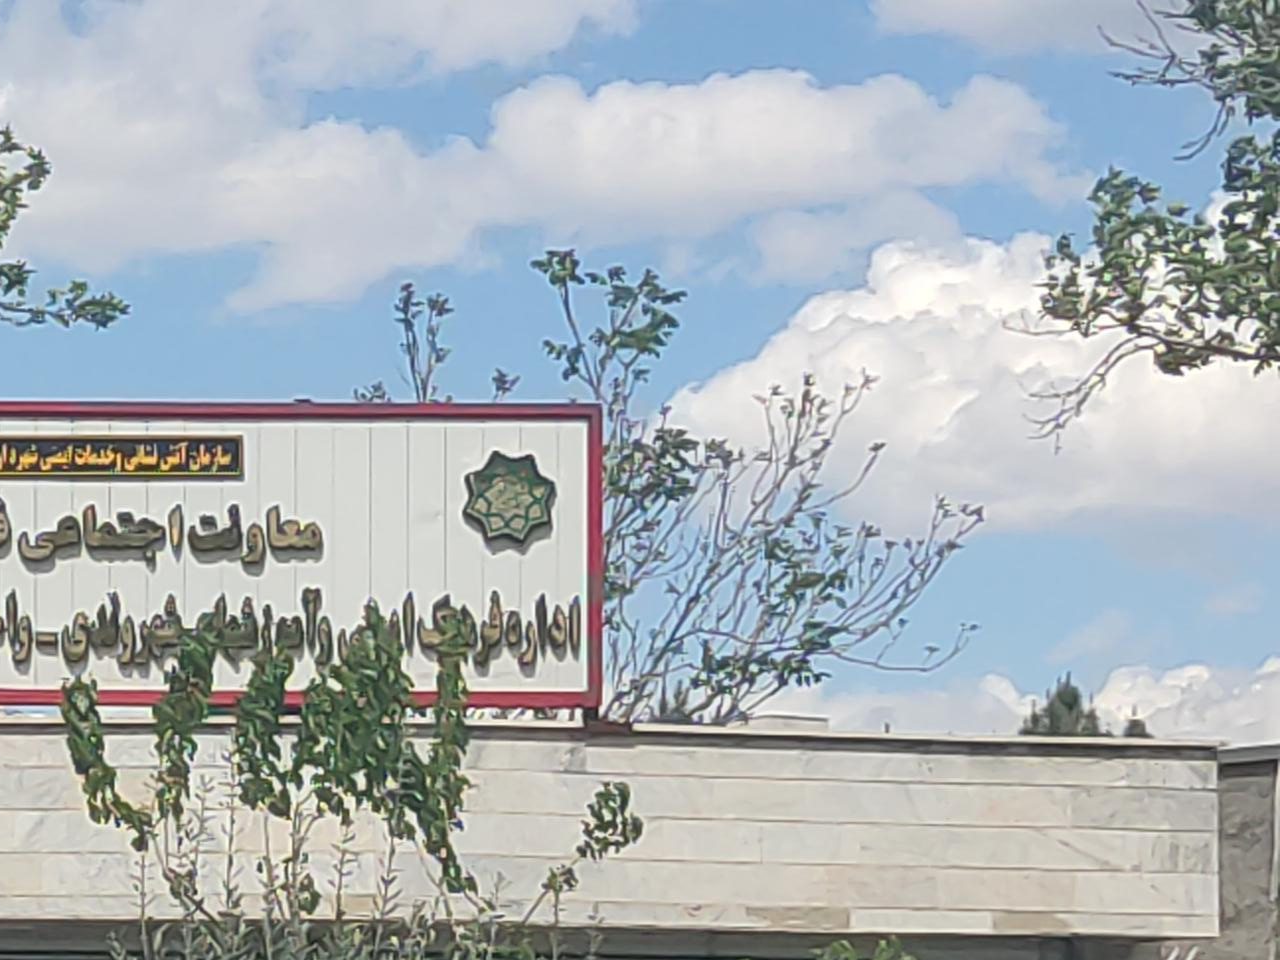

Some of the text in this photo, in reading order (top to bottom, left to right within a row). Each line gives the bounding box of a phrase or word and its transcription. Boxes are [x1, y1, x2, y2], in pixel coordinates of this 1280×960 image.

[189, 443, 232, 471] سازمان
[19, 504, 185, 563] اجتماعی
[187, 504, 324, 565] معاونت
[506, 592, 581, 664] اداره
